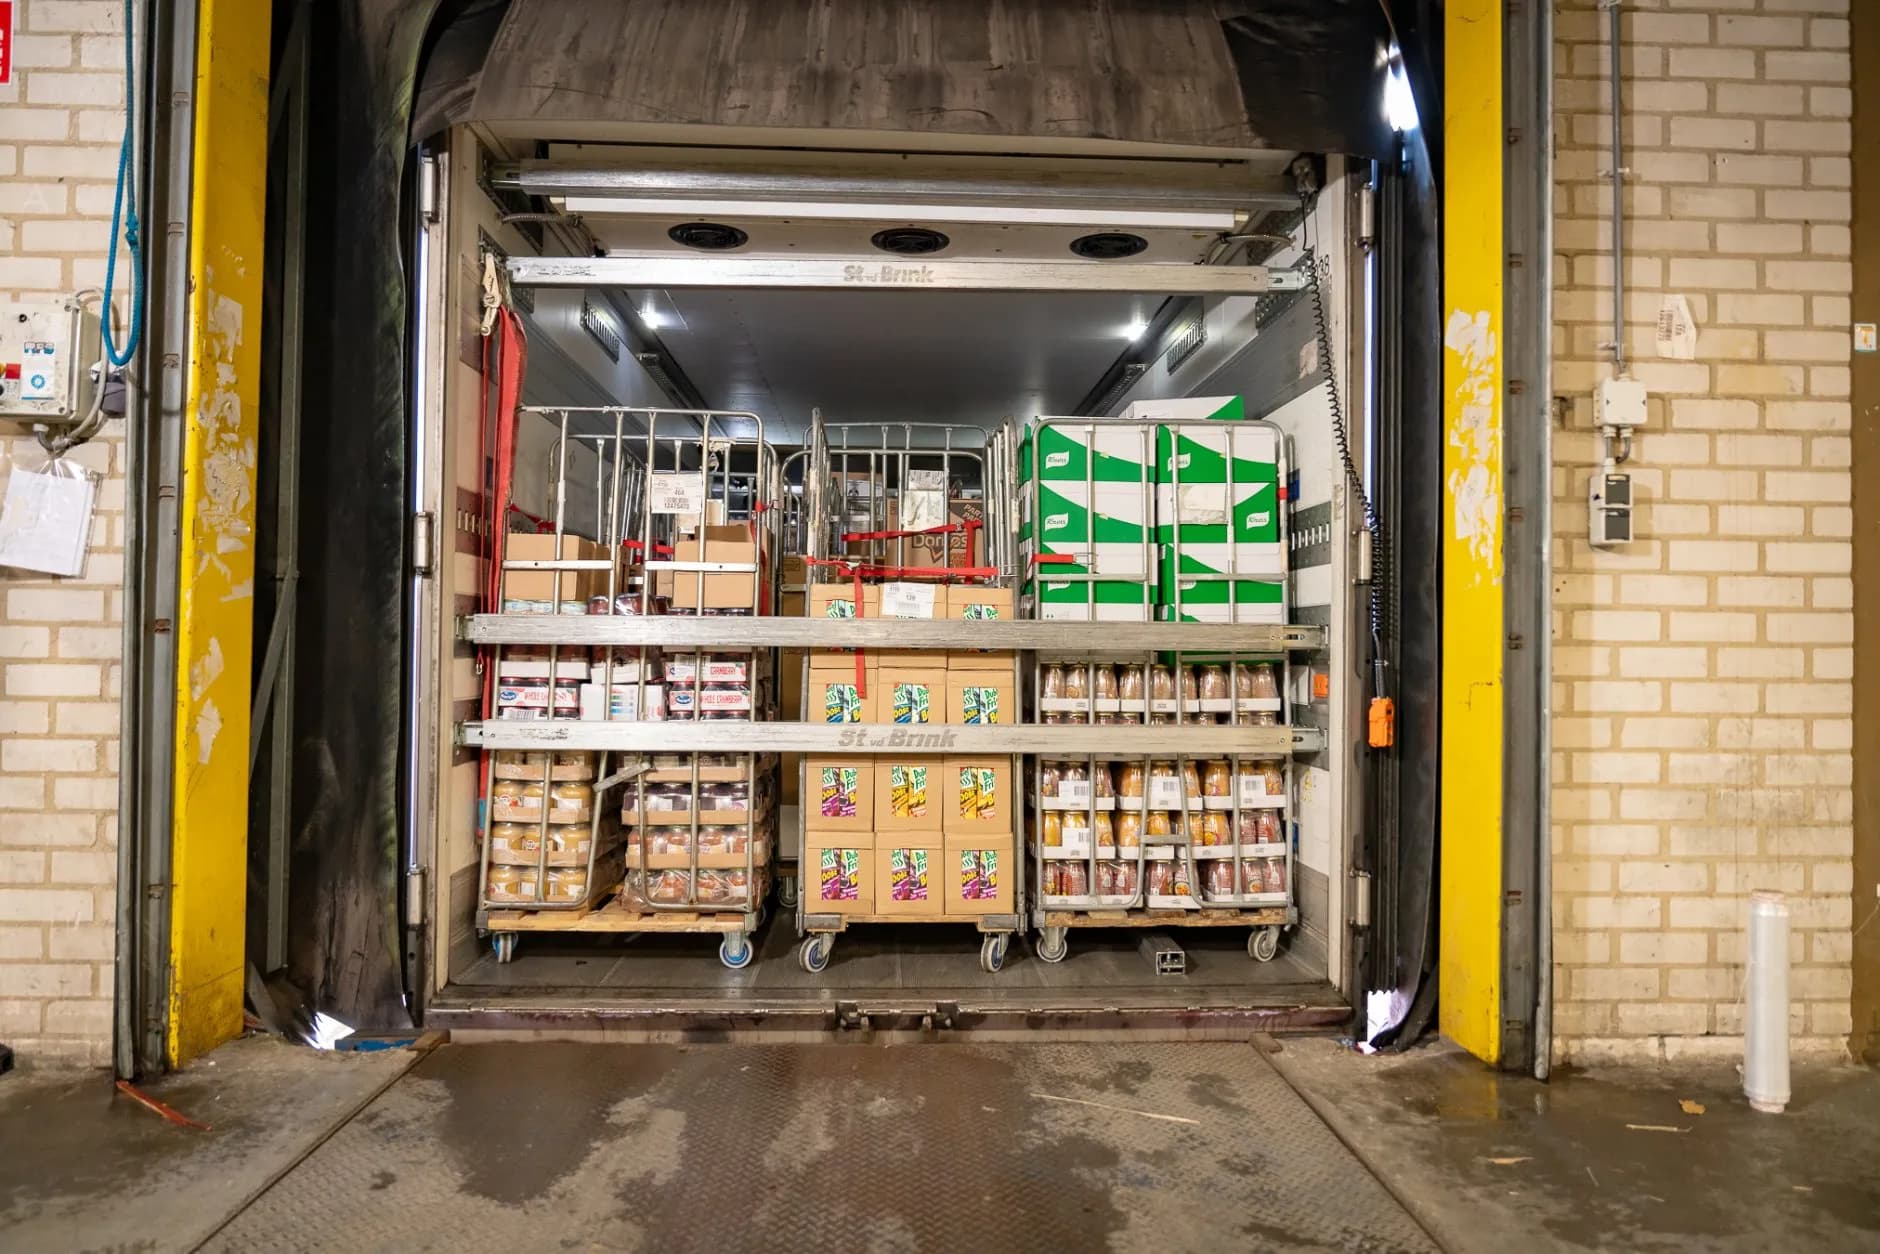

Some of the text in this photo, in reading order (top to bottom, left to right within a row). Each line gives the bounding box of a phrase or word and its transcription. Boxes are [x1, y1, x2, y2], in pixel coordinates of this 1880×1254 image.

[844, 265, 864, 282] St
[880, 264, 934, 283] Brink
[838, 729, 867, 747] St
[887, 729, 958, 748] Brink
